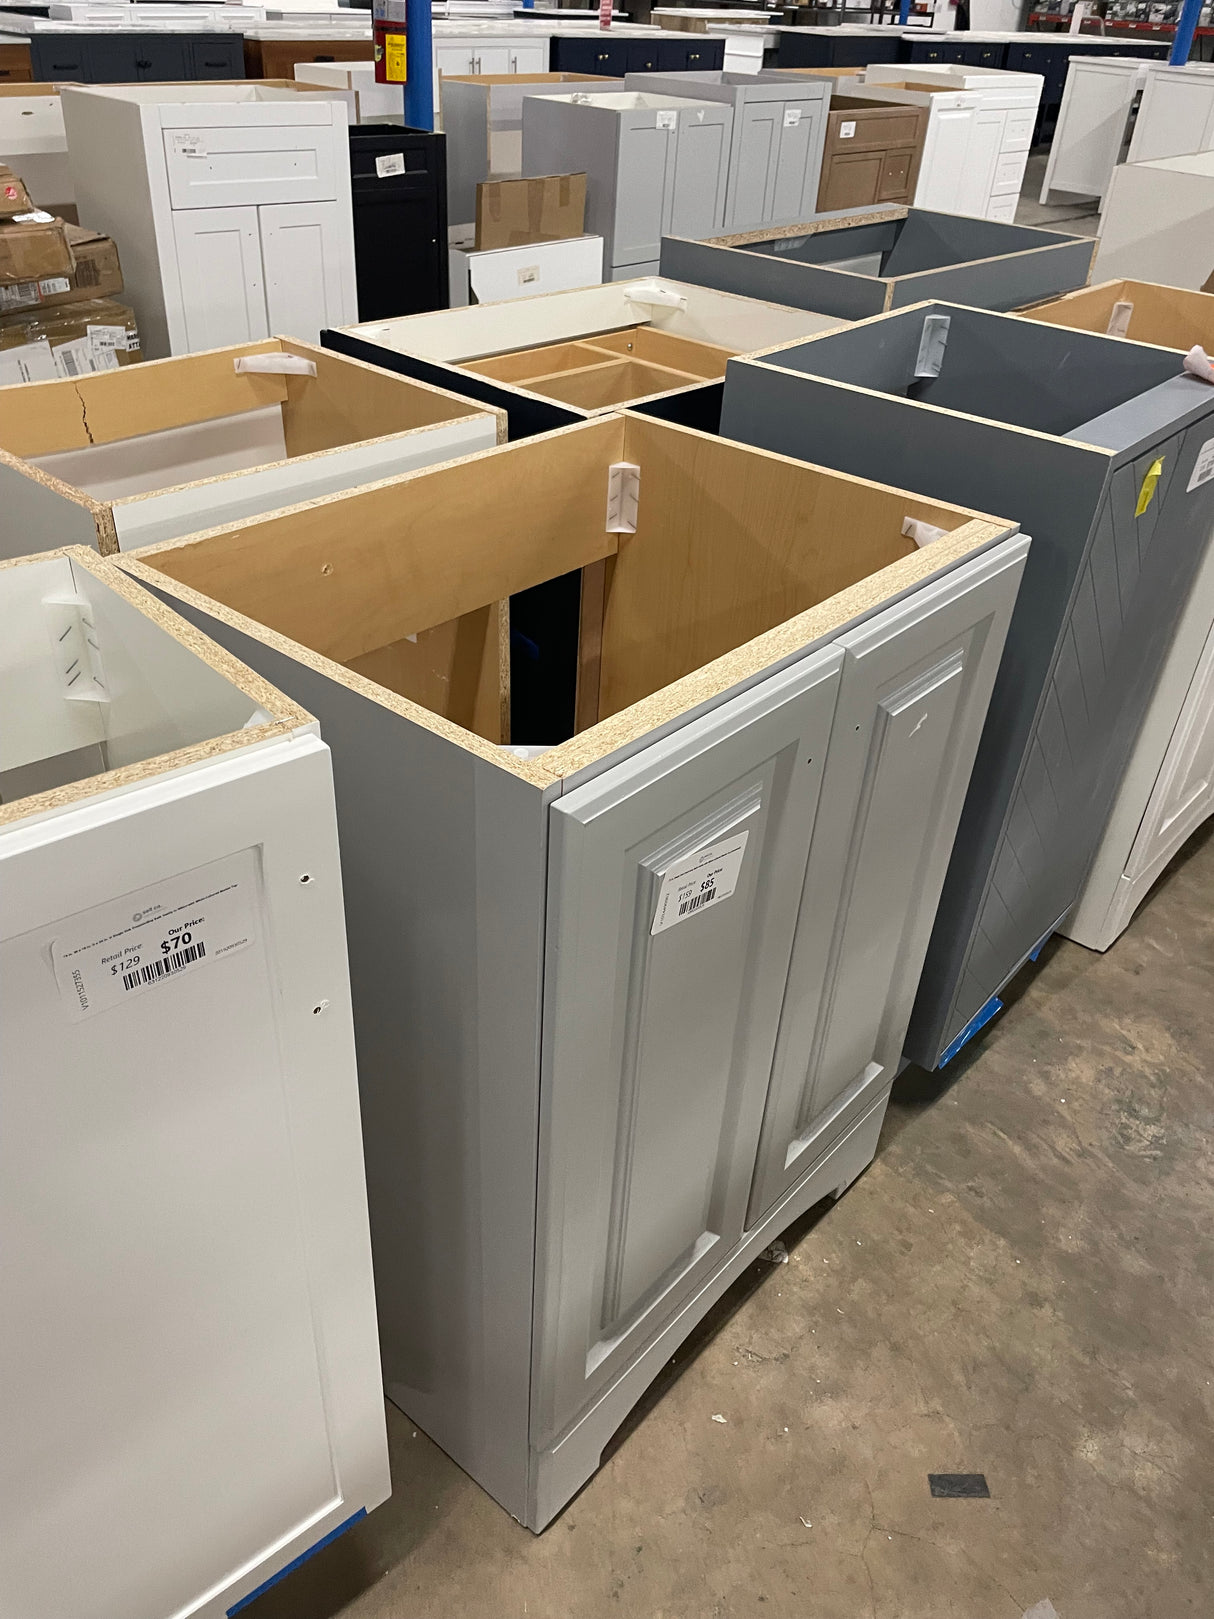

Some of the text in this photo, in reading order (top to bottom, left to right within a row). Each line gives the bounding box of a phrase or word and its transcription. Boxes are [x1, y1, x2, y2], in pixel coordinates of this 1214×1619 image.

[700, 877, 715, 892] $85
[168, 917, 206, 936] Our Price:
[101, 943, 143, 965] Retail Price:
[160, 932, 192, 955] $70
[111, 955, 141, 976] $129
